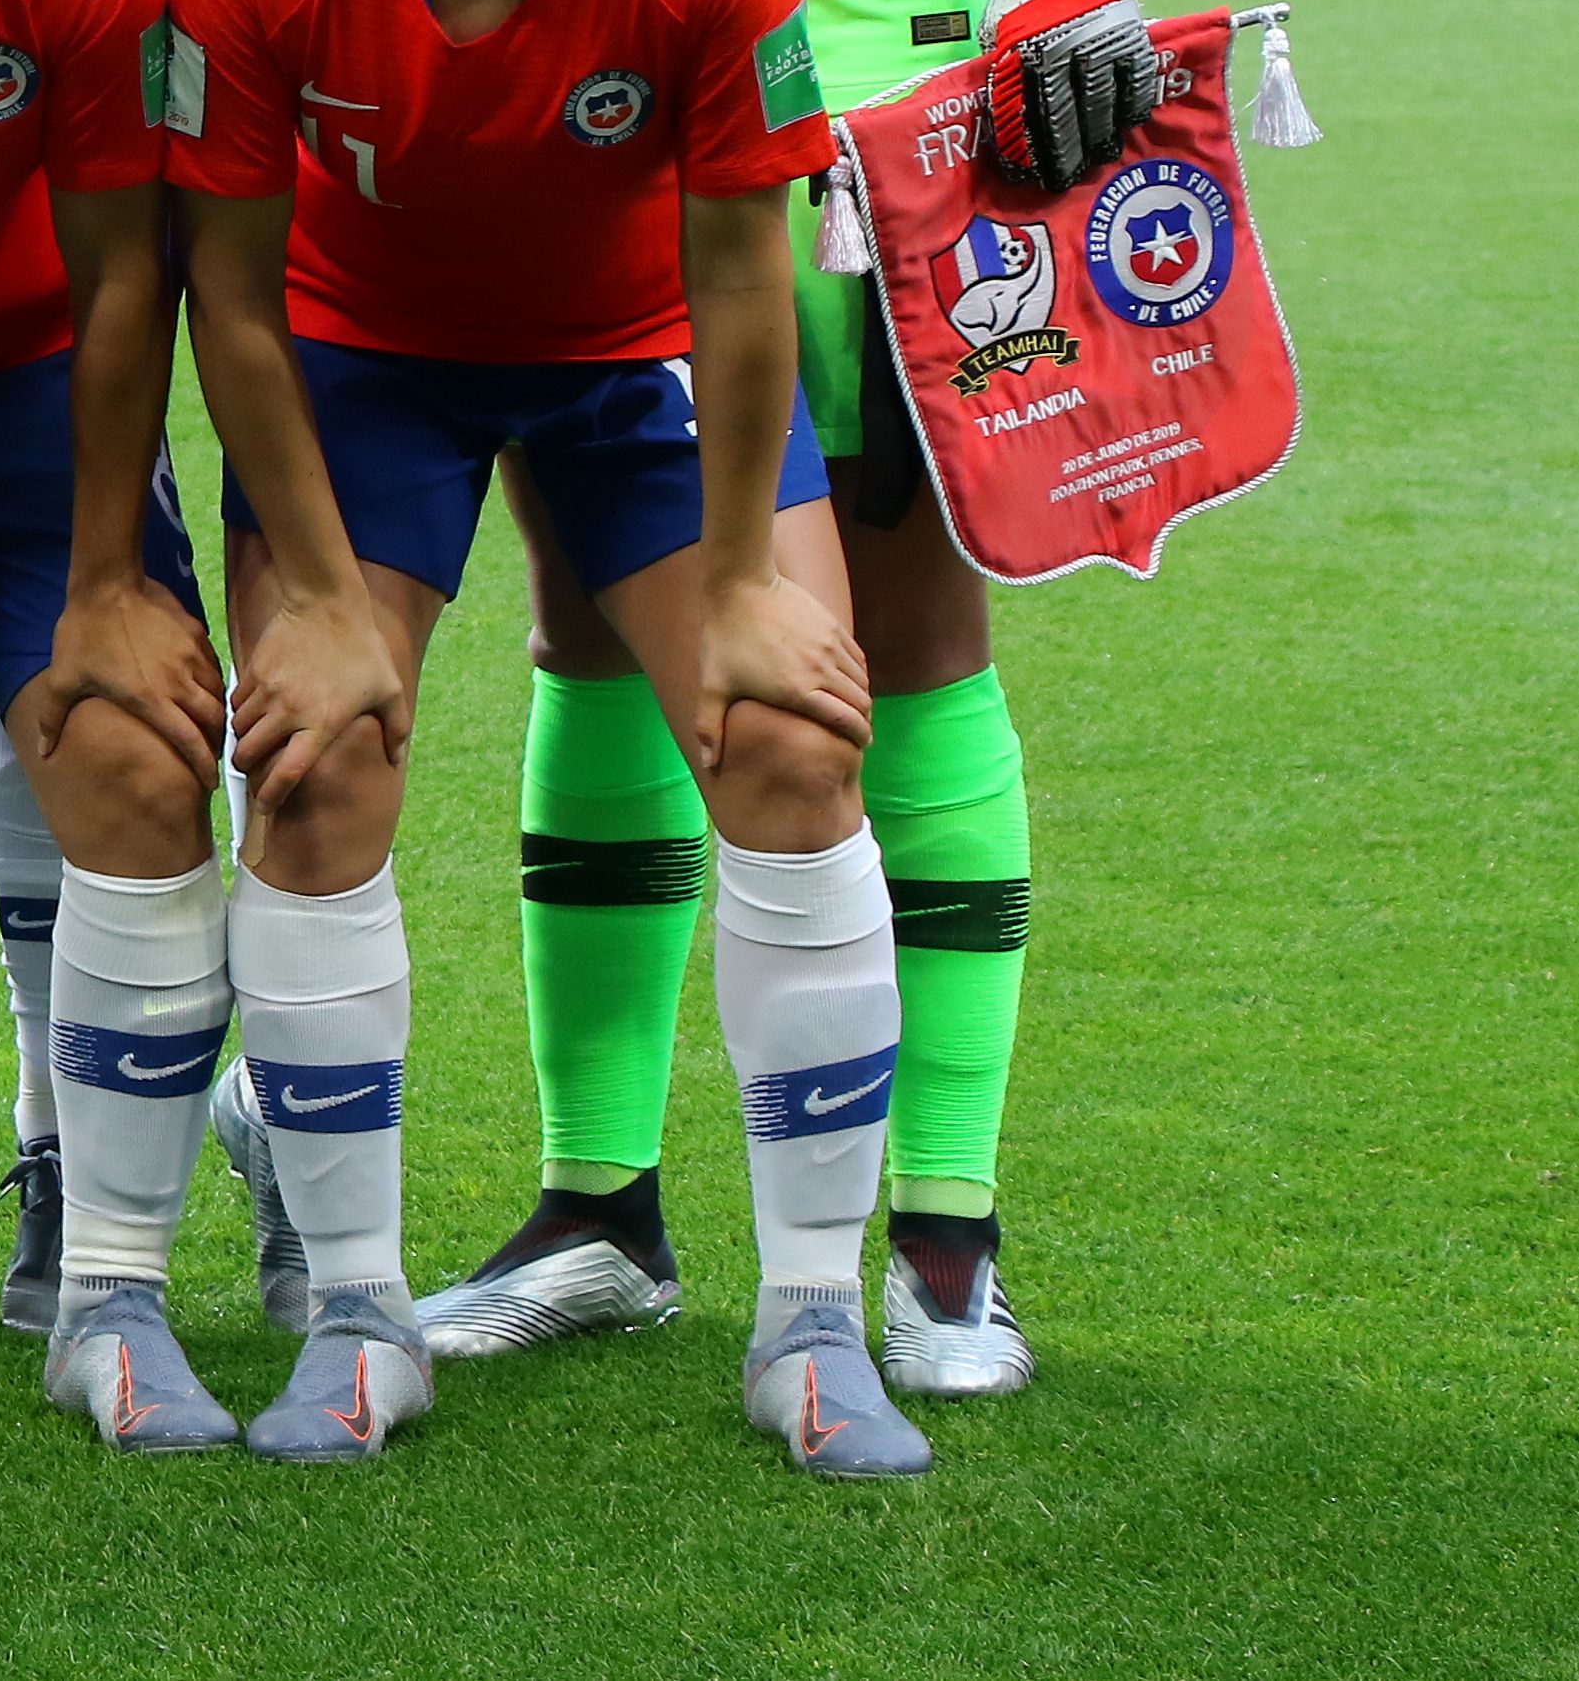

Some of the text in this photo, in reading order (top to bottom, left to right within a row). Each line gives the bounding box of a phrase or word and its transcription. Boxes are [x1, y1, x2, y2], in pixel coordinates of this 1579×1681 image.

[1089, 165, 1229, 262] FEDERACION DE FUTBOL
[1138, 285, 1214, 322] DE CHILE
[969, 334, 1058, 372] TEAMHAI
[1151, 344, 1215, 377] CHILE
[974, 387, 1086, 437] TAILANDIA
[1061, 421, 1182, 475] 20 DE JUNIO DE 2019
[1049, 469, 1110, 504] ROAZHON
[1097, 472, 1156, 504] FRANCIA
